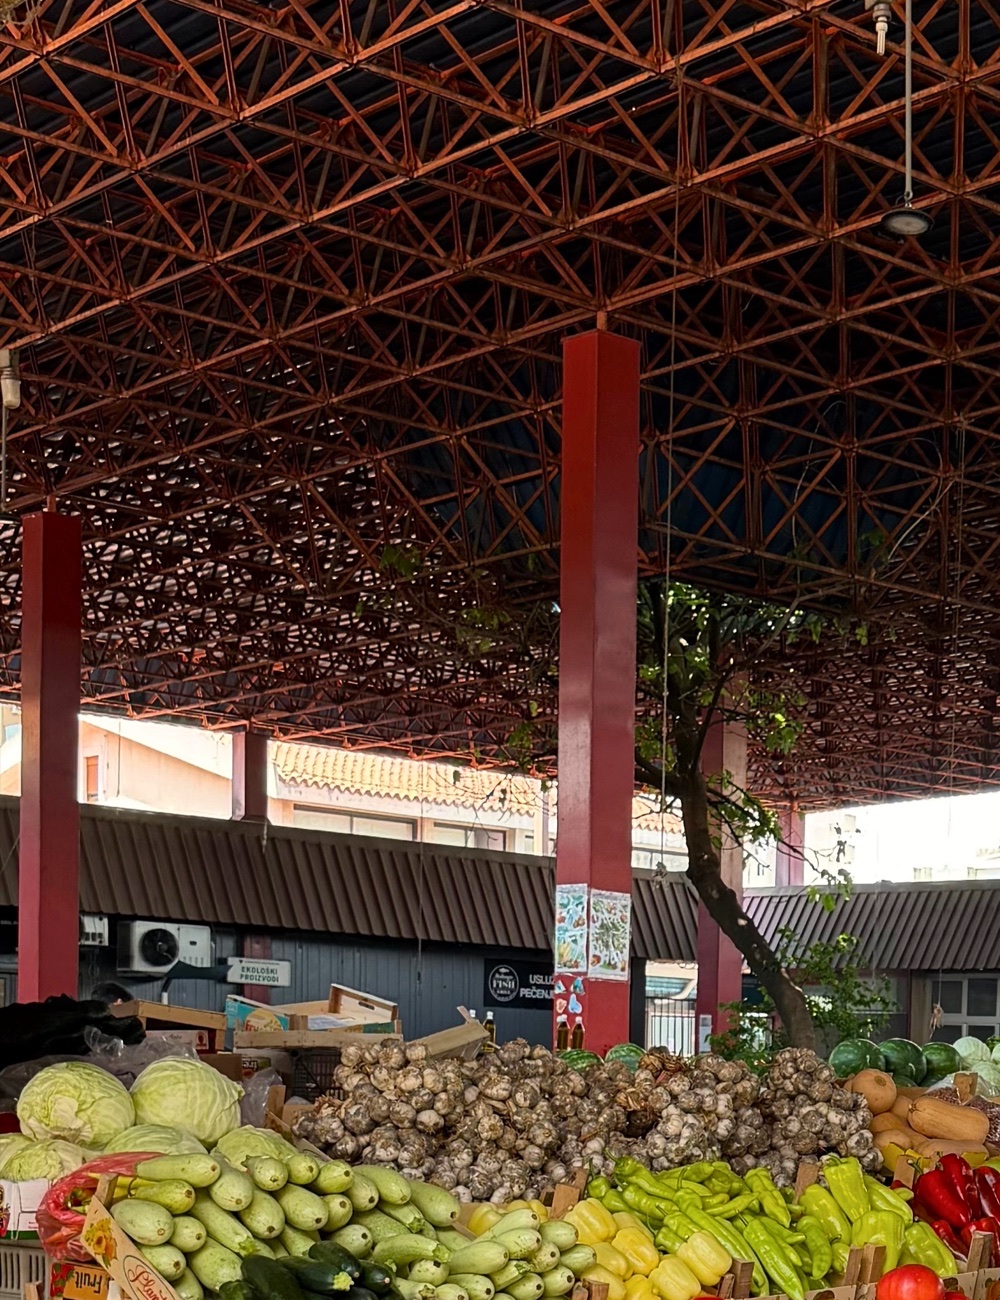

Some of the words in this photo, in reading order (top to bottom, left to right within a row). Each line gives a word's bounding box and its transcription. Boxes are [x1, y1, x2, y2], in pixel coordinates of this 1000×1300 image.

[241, 966, 278, 975] EKOLOŠKI
[240, 973, 279, 983] PROIZVODI
[75, 1271, 102, 1294] Fruit
